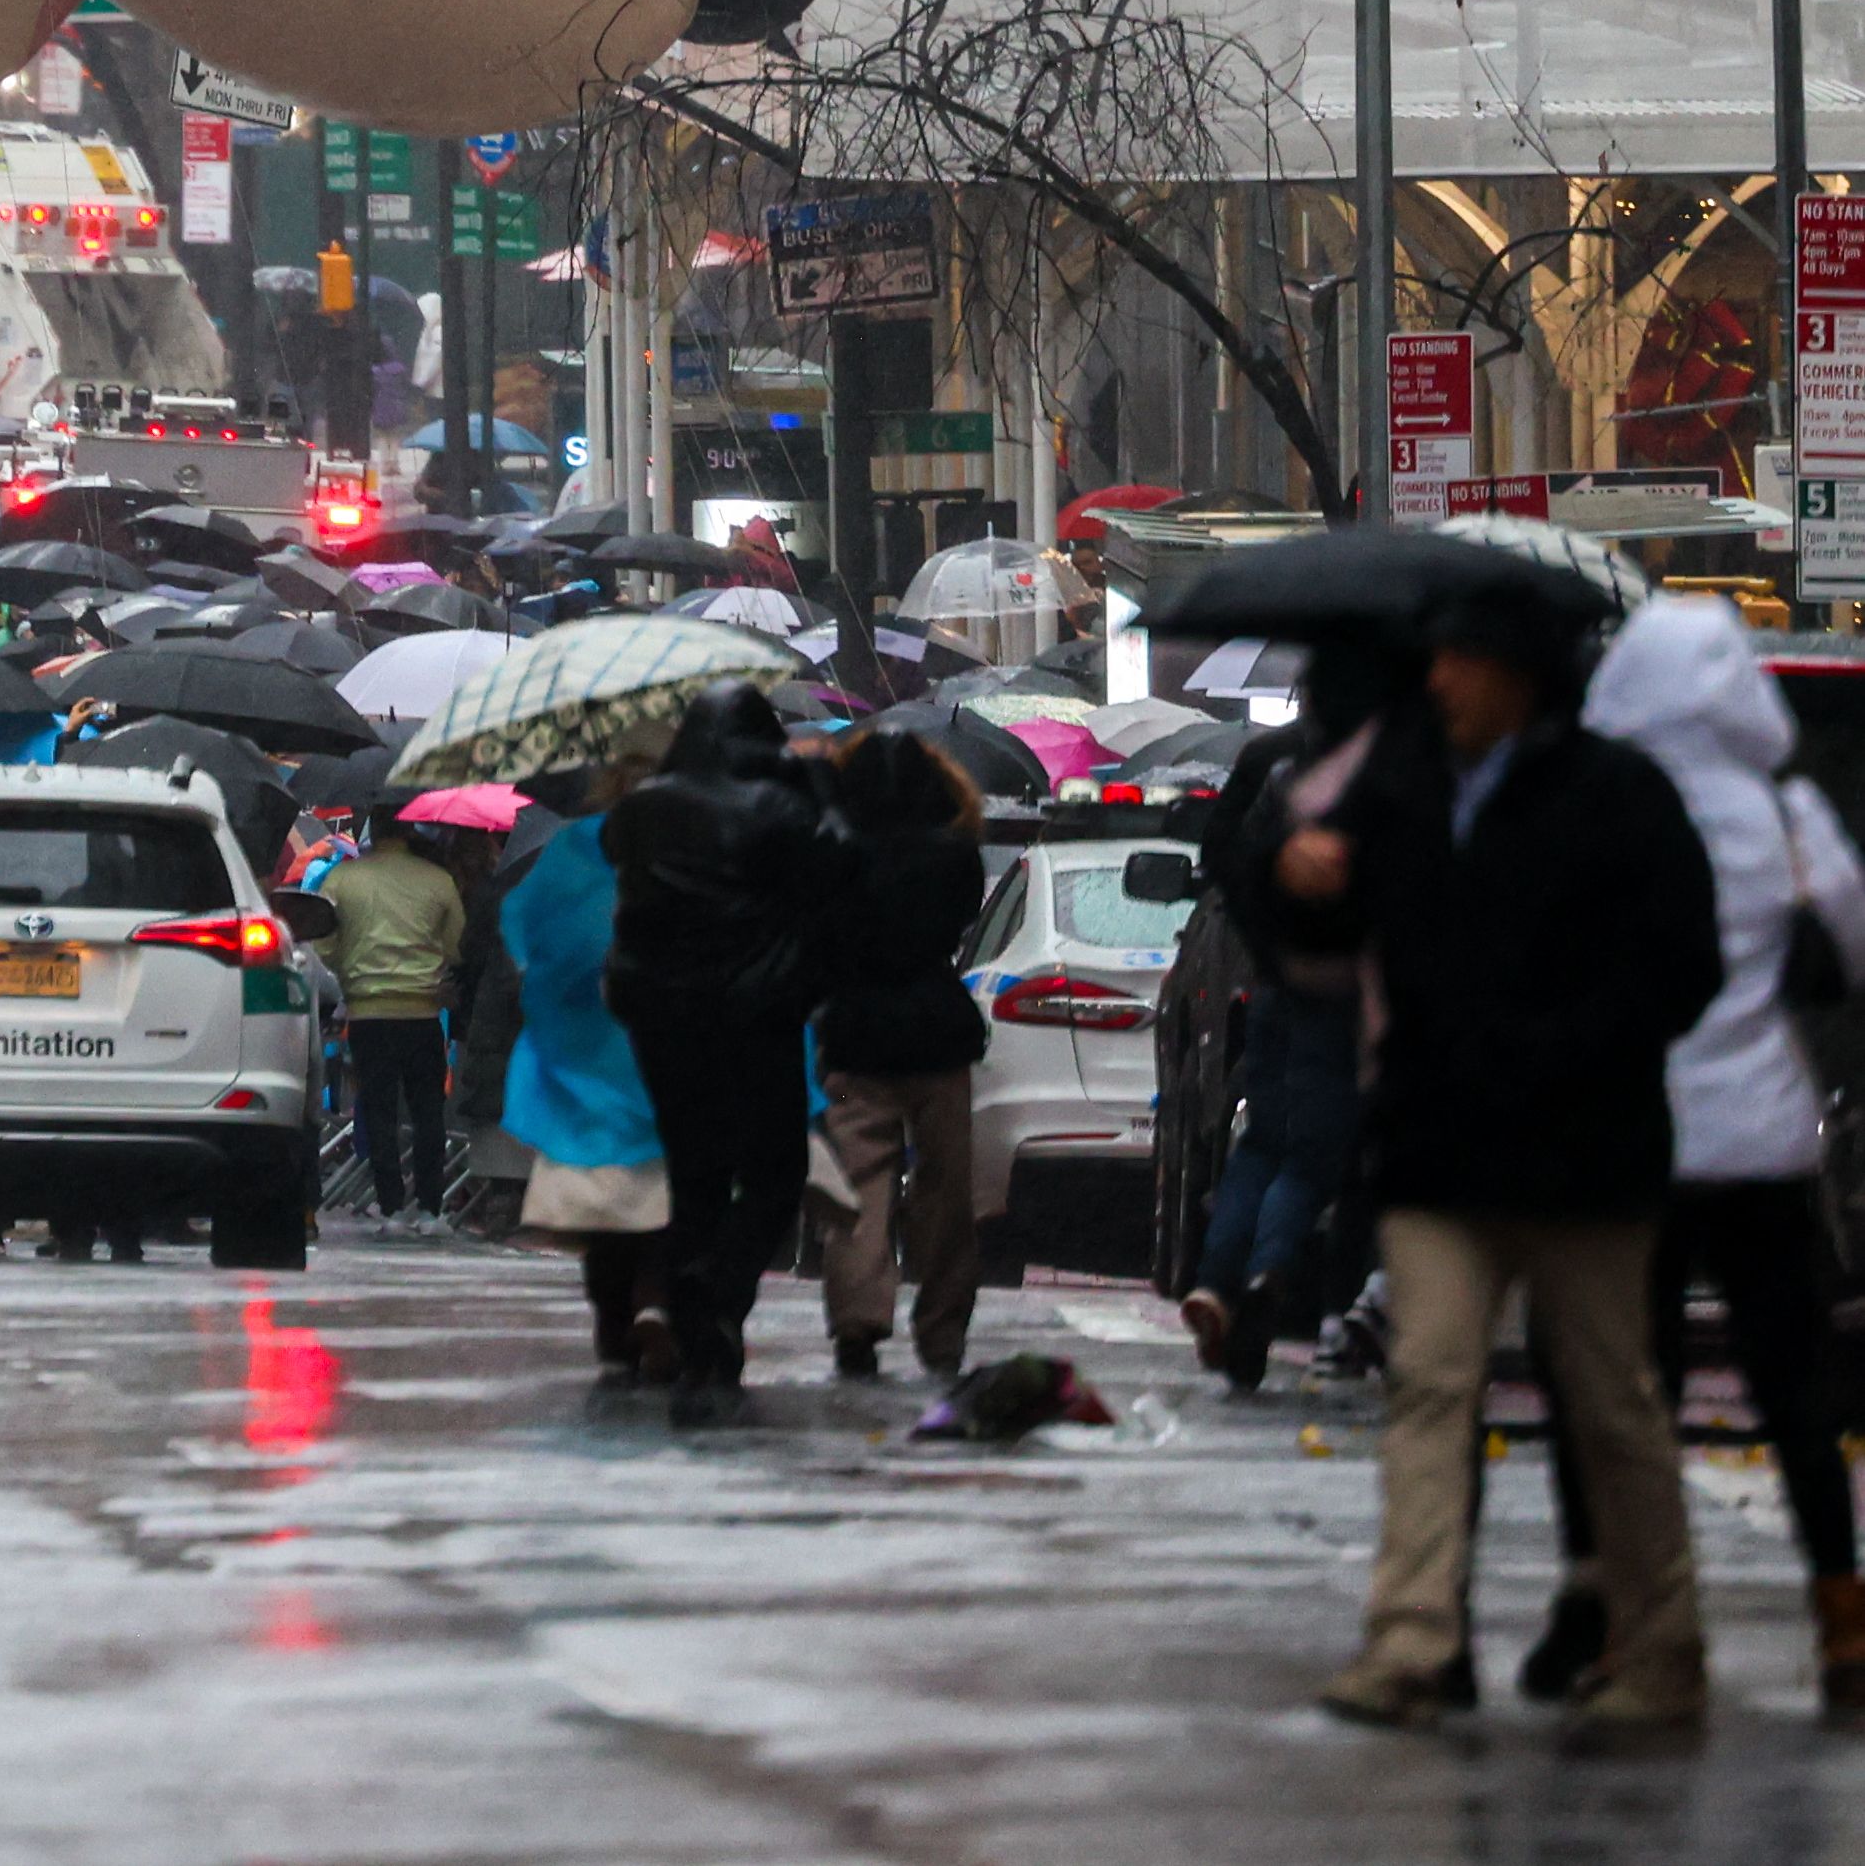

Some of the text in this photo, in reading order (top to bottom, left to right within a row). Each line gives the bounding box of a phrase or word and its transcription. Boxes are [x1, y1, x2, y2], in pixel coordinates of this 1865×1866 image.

[204, 88, 232, 108] MON
[267, 100, 286, 121] FRI
[1803, 203, 1821, 221] NO
[1392, 339, 1459, 357] NO STANDING
[1807, 314, 1826, 352] 3
[1398, 441, 1411, 471] 3
[1451, 485, 1469, 503] NO
[1807, 483, 1827, 517] 5
